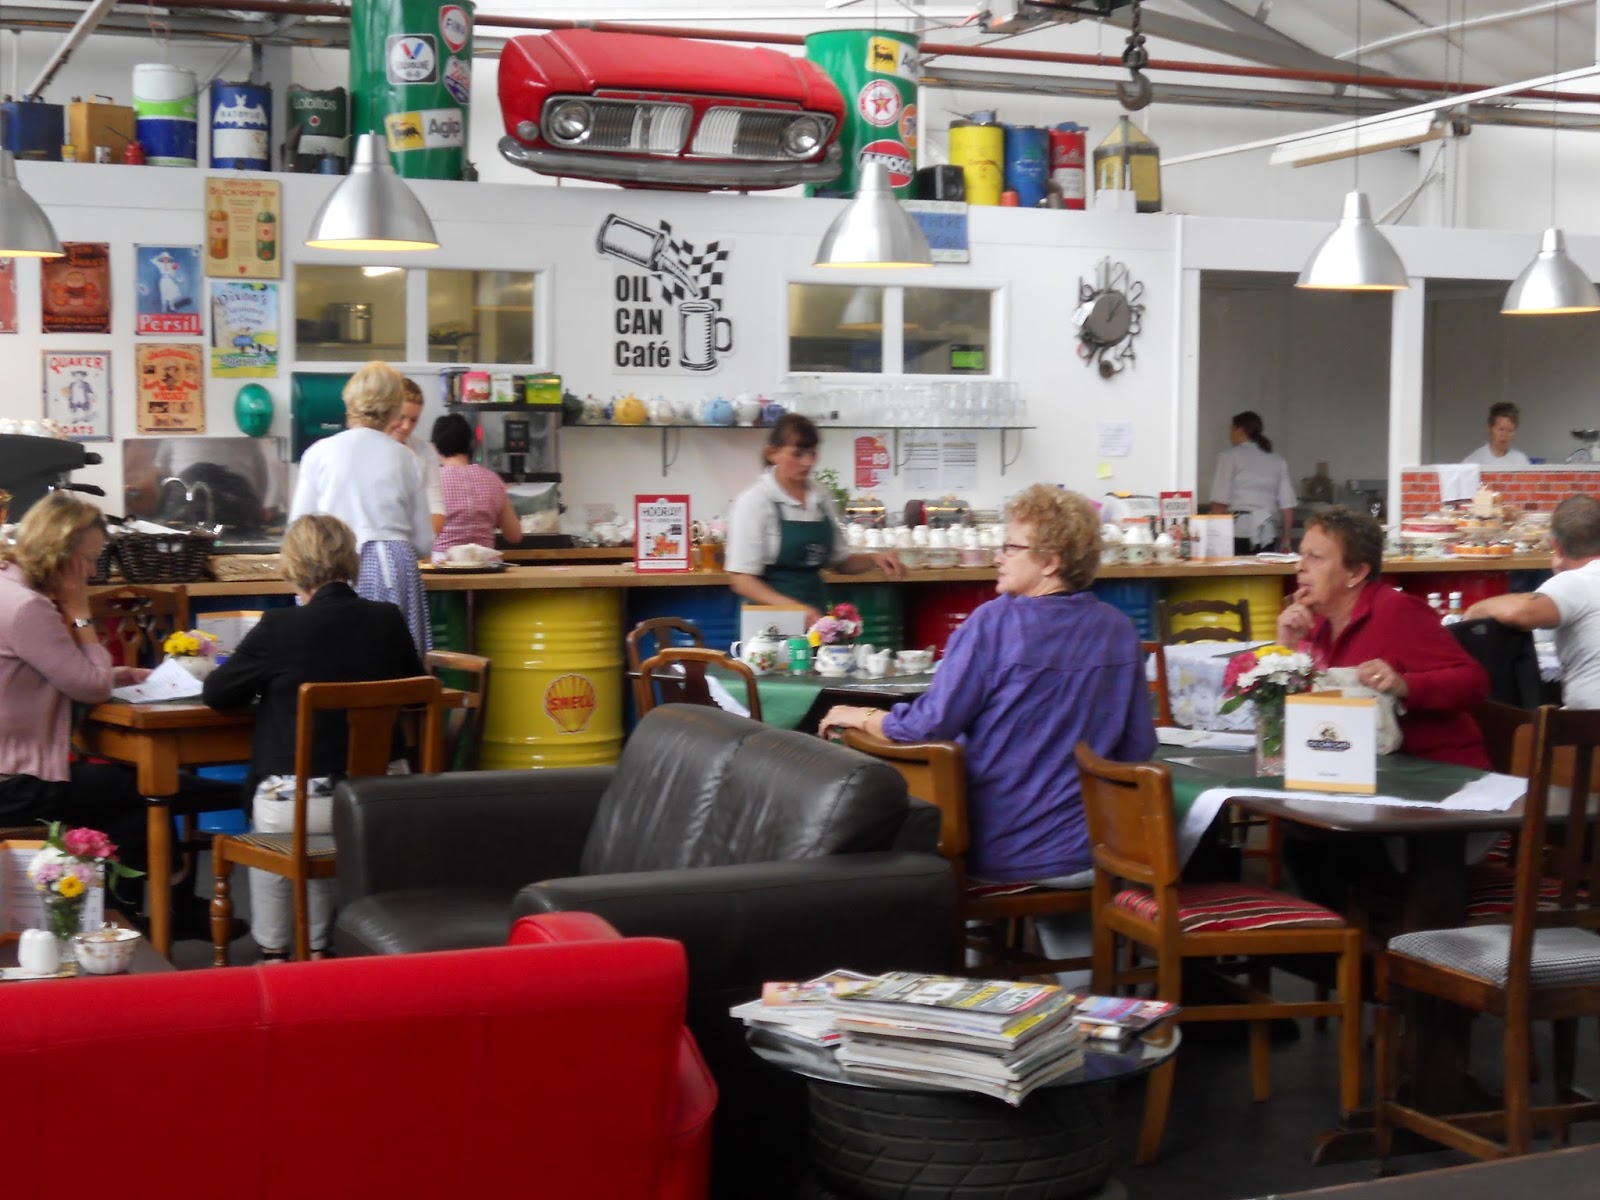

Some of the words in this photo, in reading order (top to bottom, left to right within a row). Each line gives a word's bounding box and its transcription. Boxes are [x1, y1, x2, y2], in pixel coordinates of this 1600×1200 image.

[428, 117, 461, 139] Agip
[615, 274, 652, 302] OIL
[140, 314, 198, 331] Persil
[615, 308, 663, 335] CAN
[615, 340, 671, 367] Café
[49, 355, 104, 375] QUAKER
[62, 425, 95, 435] OATS
